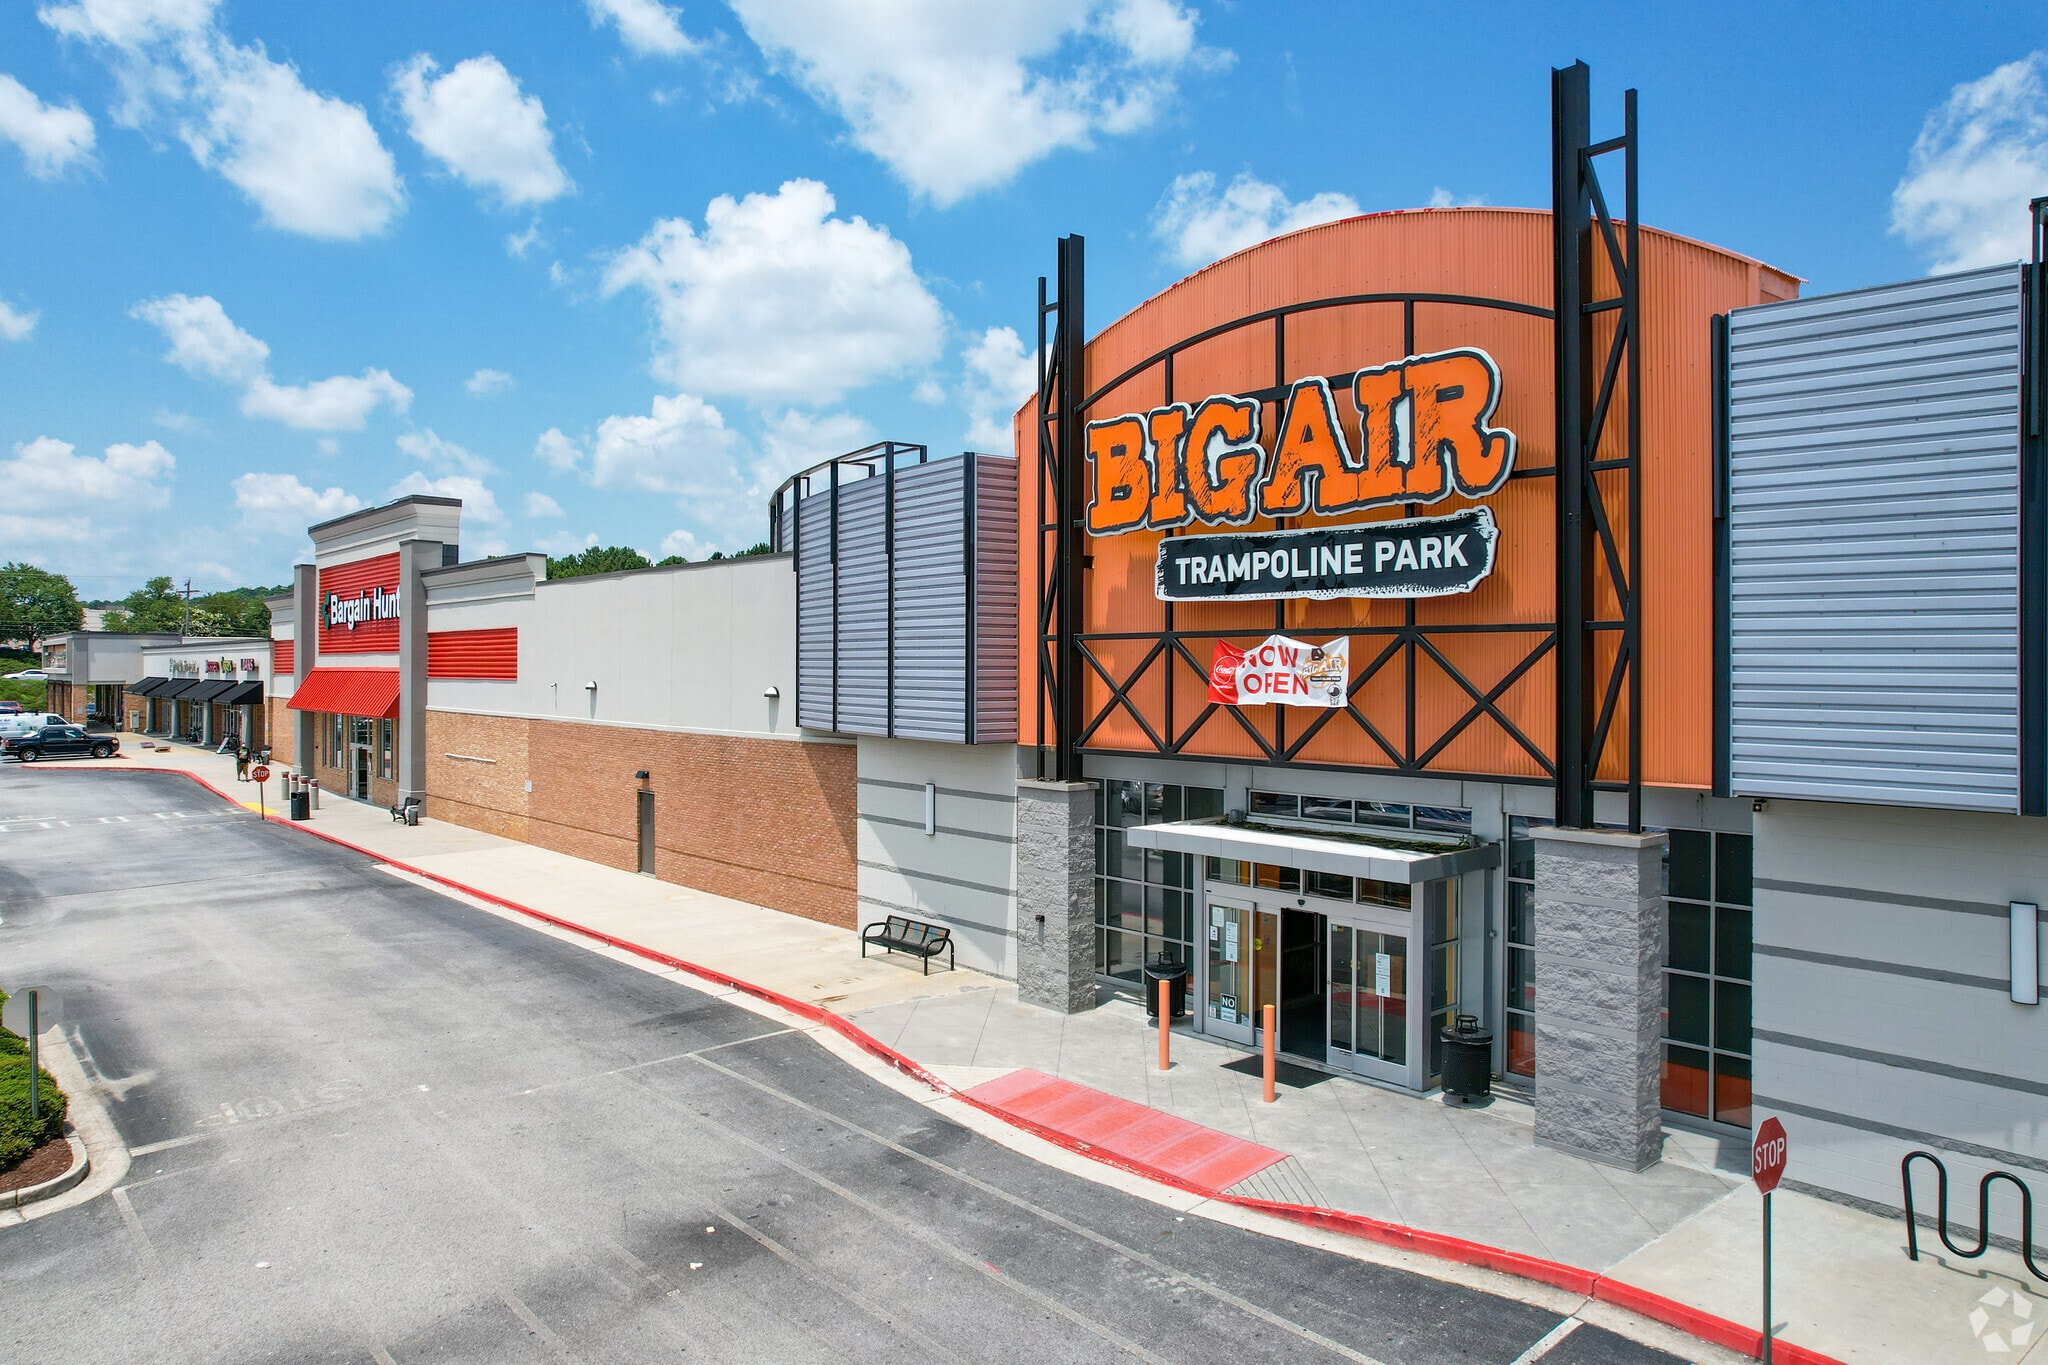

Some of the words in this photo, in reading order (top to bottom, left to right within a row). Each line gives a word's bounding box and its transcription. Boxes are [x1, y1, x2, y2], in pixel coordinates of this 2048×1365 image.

[1085, 395, 1265, 536] BIG
[1256, 346, 1516, 518] AIR
[1175, 543, 1364, 586] TRAMPOLINE
[1375, 534, 1470, 573] PARK
[331, 590, 370, 630] Bargain
[253, 770, 269, 778] STOP
[1222, 996, 1235, 1008] NO
[1754, 1137, 1785, 1174] STOP
